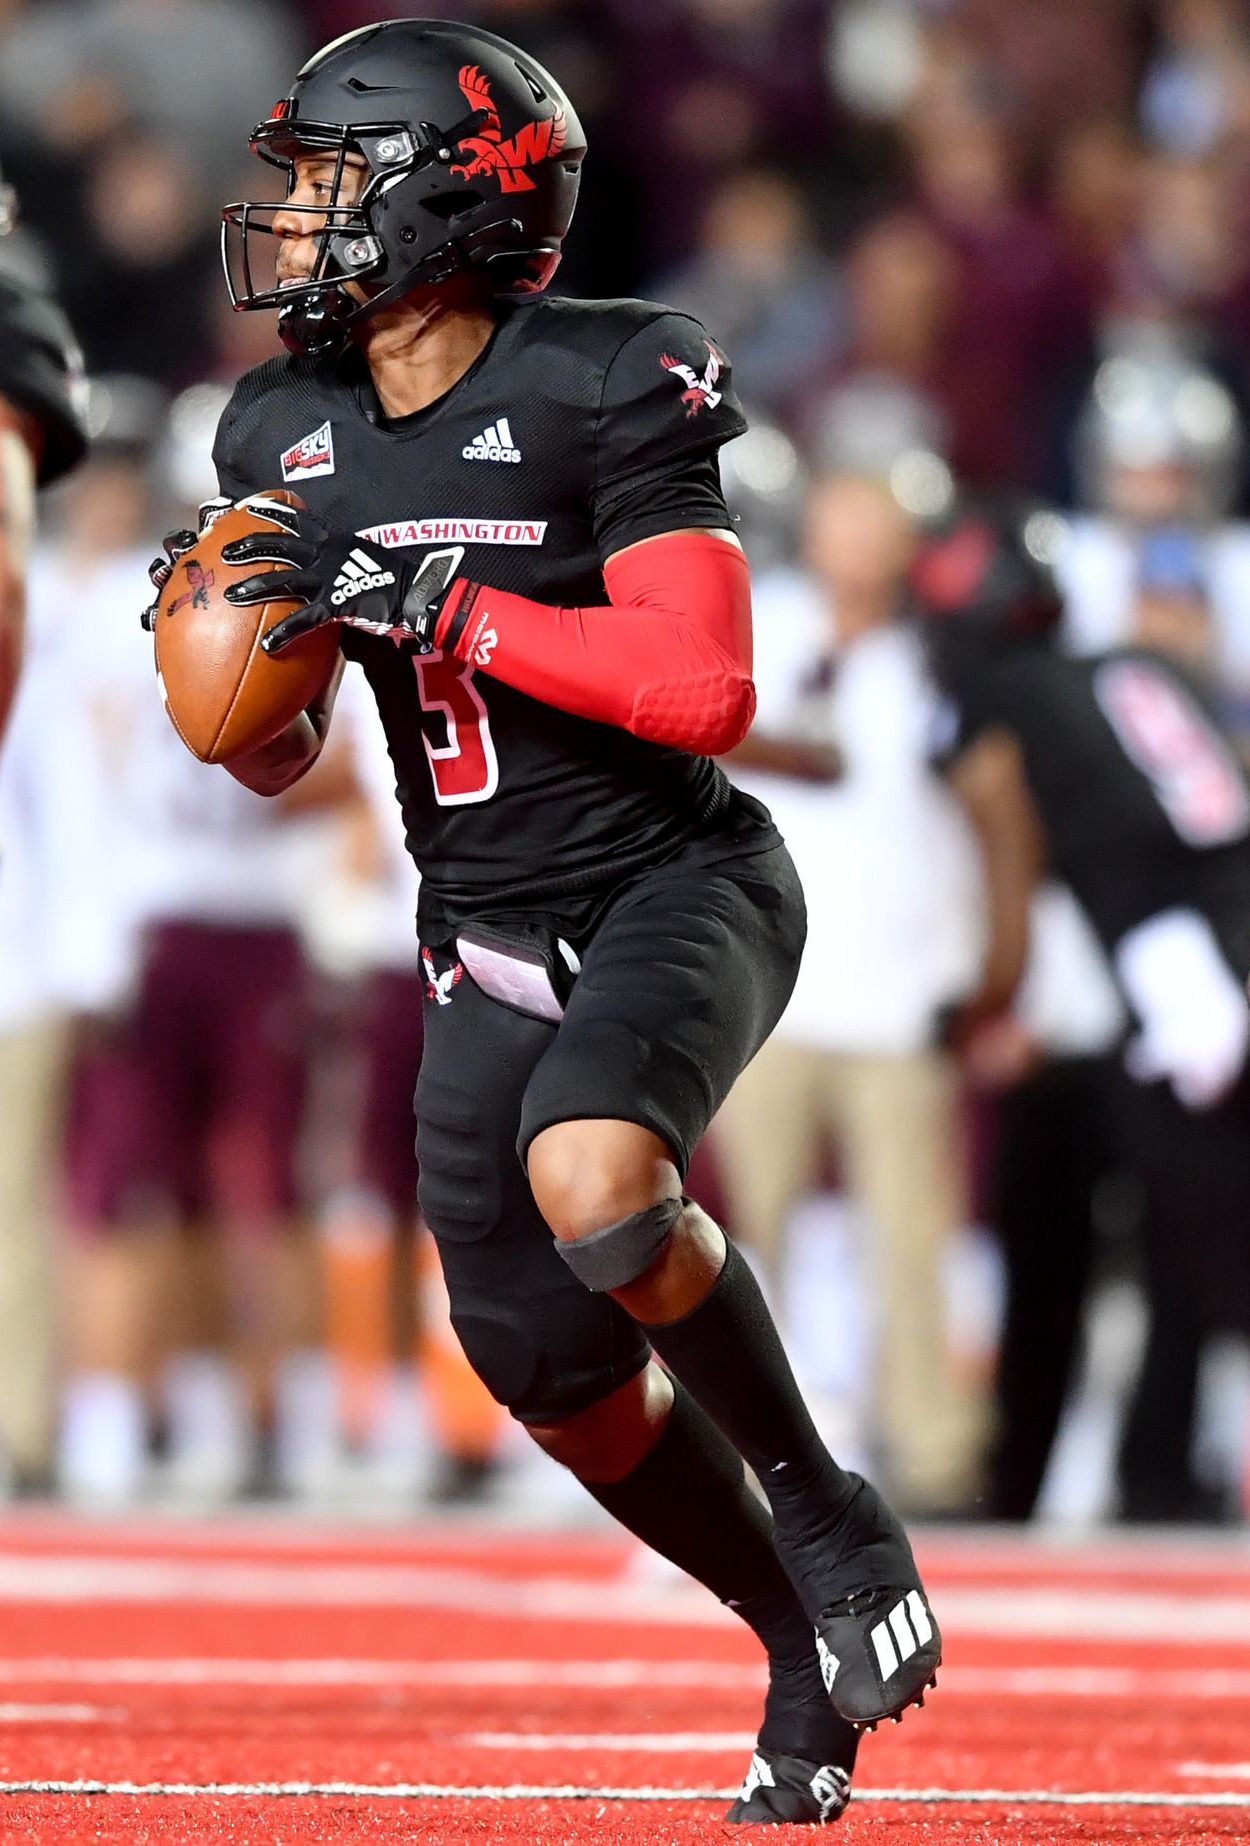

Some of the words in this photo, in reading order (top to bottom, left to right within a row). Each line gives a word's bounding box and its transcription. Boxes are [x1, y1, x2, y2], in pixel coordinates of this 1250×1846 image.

[462, 442, 522, 463] adidas
[383, 522, 542, 545] WASHINGTON
[331, 571, 396, 606] adidas
